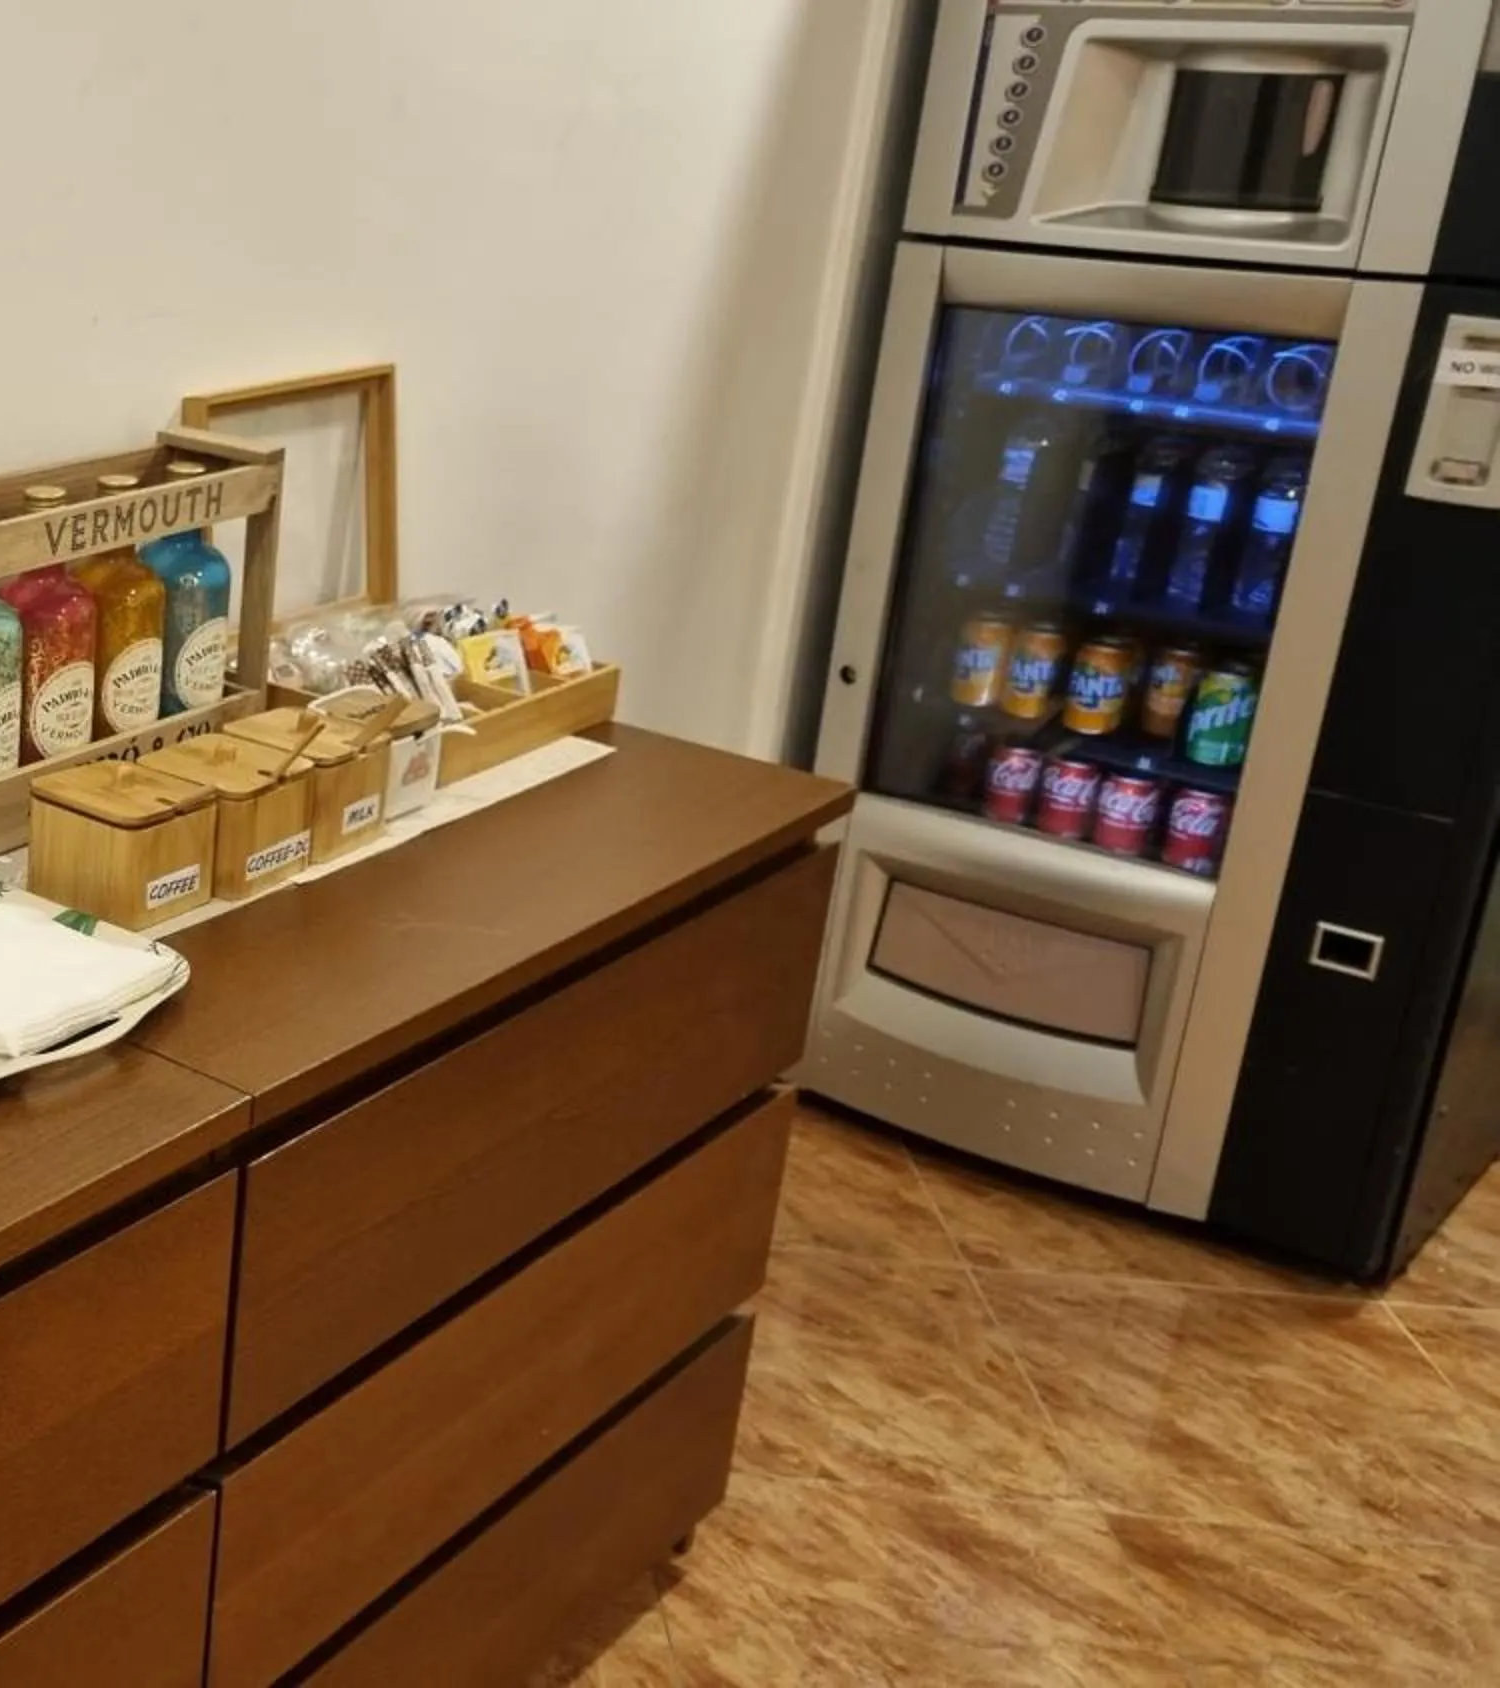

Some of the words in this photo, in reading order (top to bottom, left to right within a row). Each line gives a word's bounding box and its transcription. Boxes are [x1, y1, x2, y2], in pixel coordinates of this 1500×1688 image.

[43, 481, 223, 556] VERMOUTH
[346, 805, 375, 827] MILK
[150, 873, 198, 900] COFFEE
